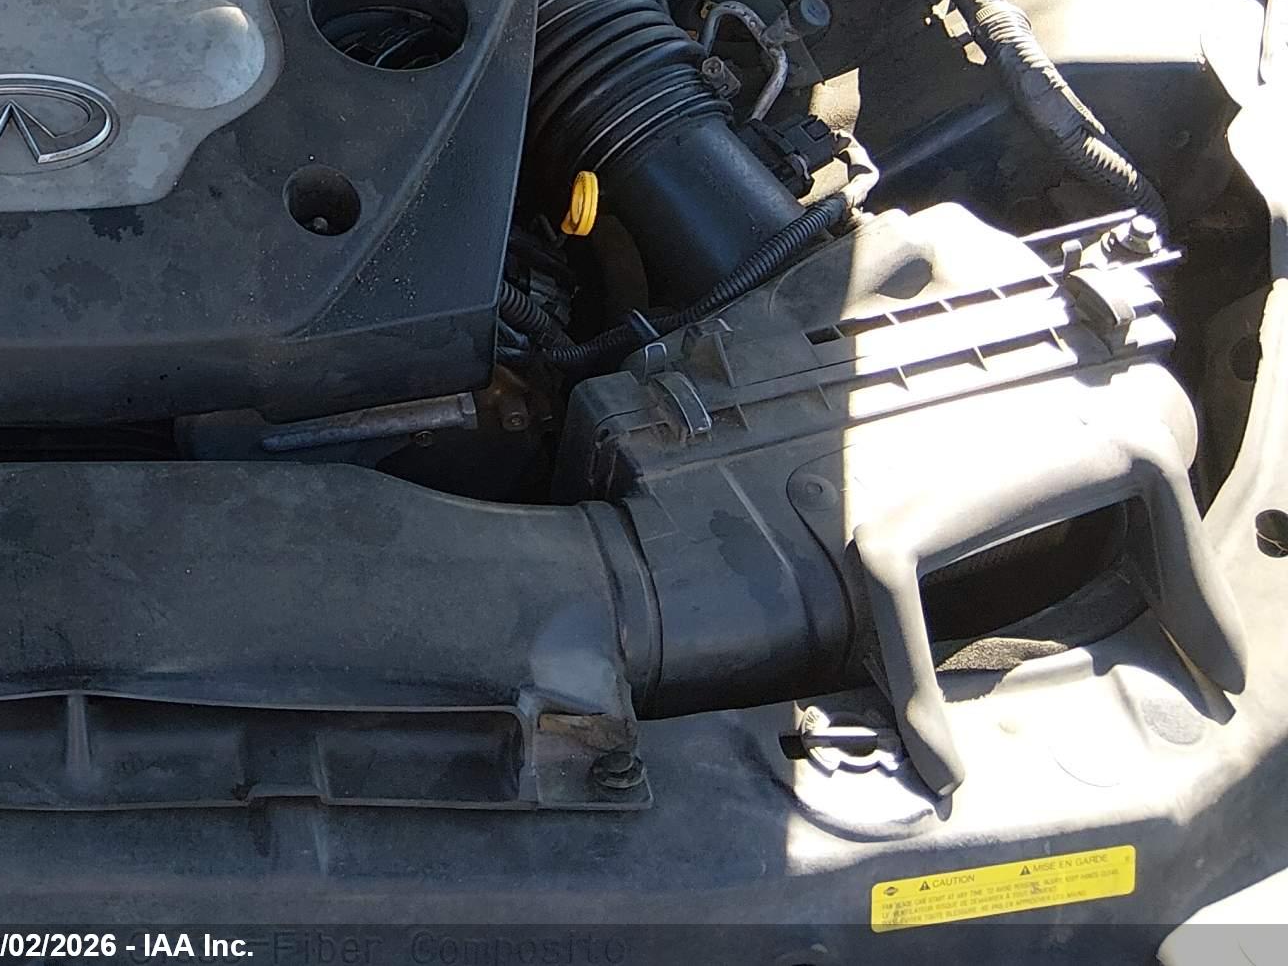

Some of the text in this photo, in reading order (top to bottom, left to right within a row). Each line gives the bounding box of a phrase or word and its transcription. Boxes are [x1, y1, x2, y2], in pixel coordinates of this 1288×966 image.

[932, 854, 1108, 889] CAUTION MISE EN GARDE
